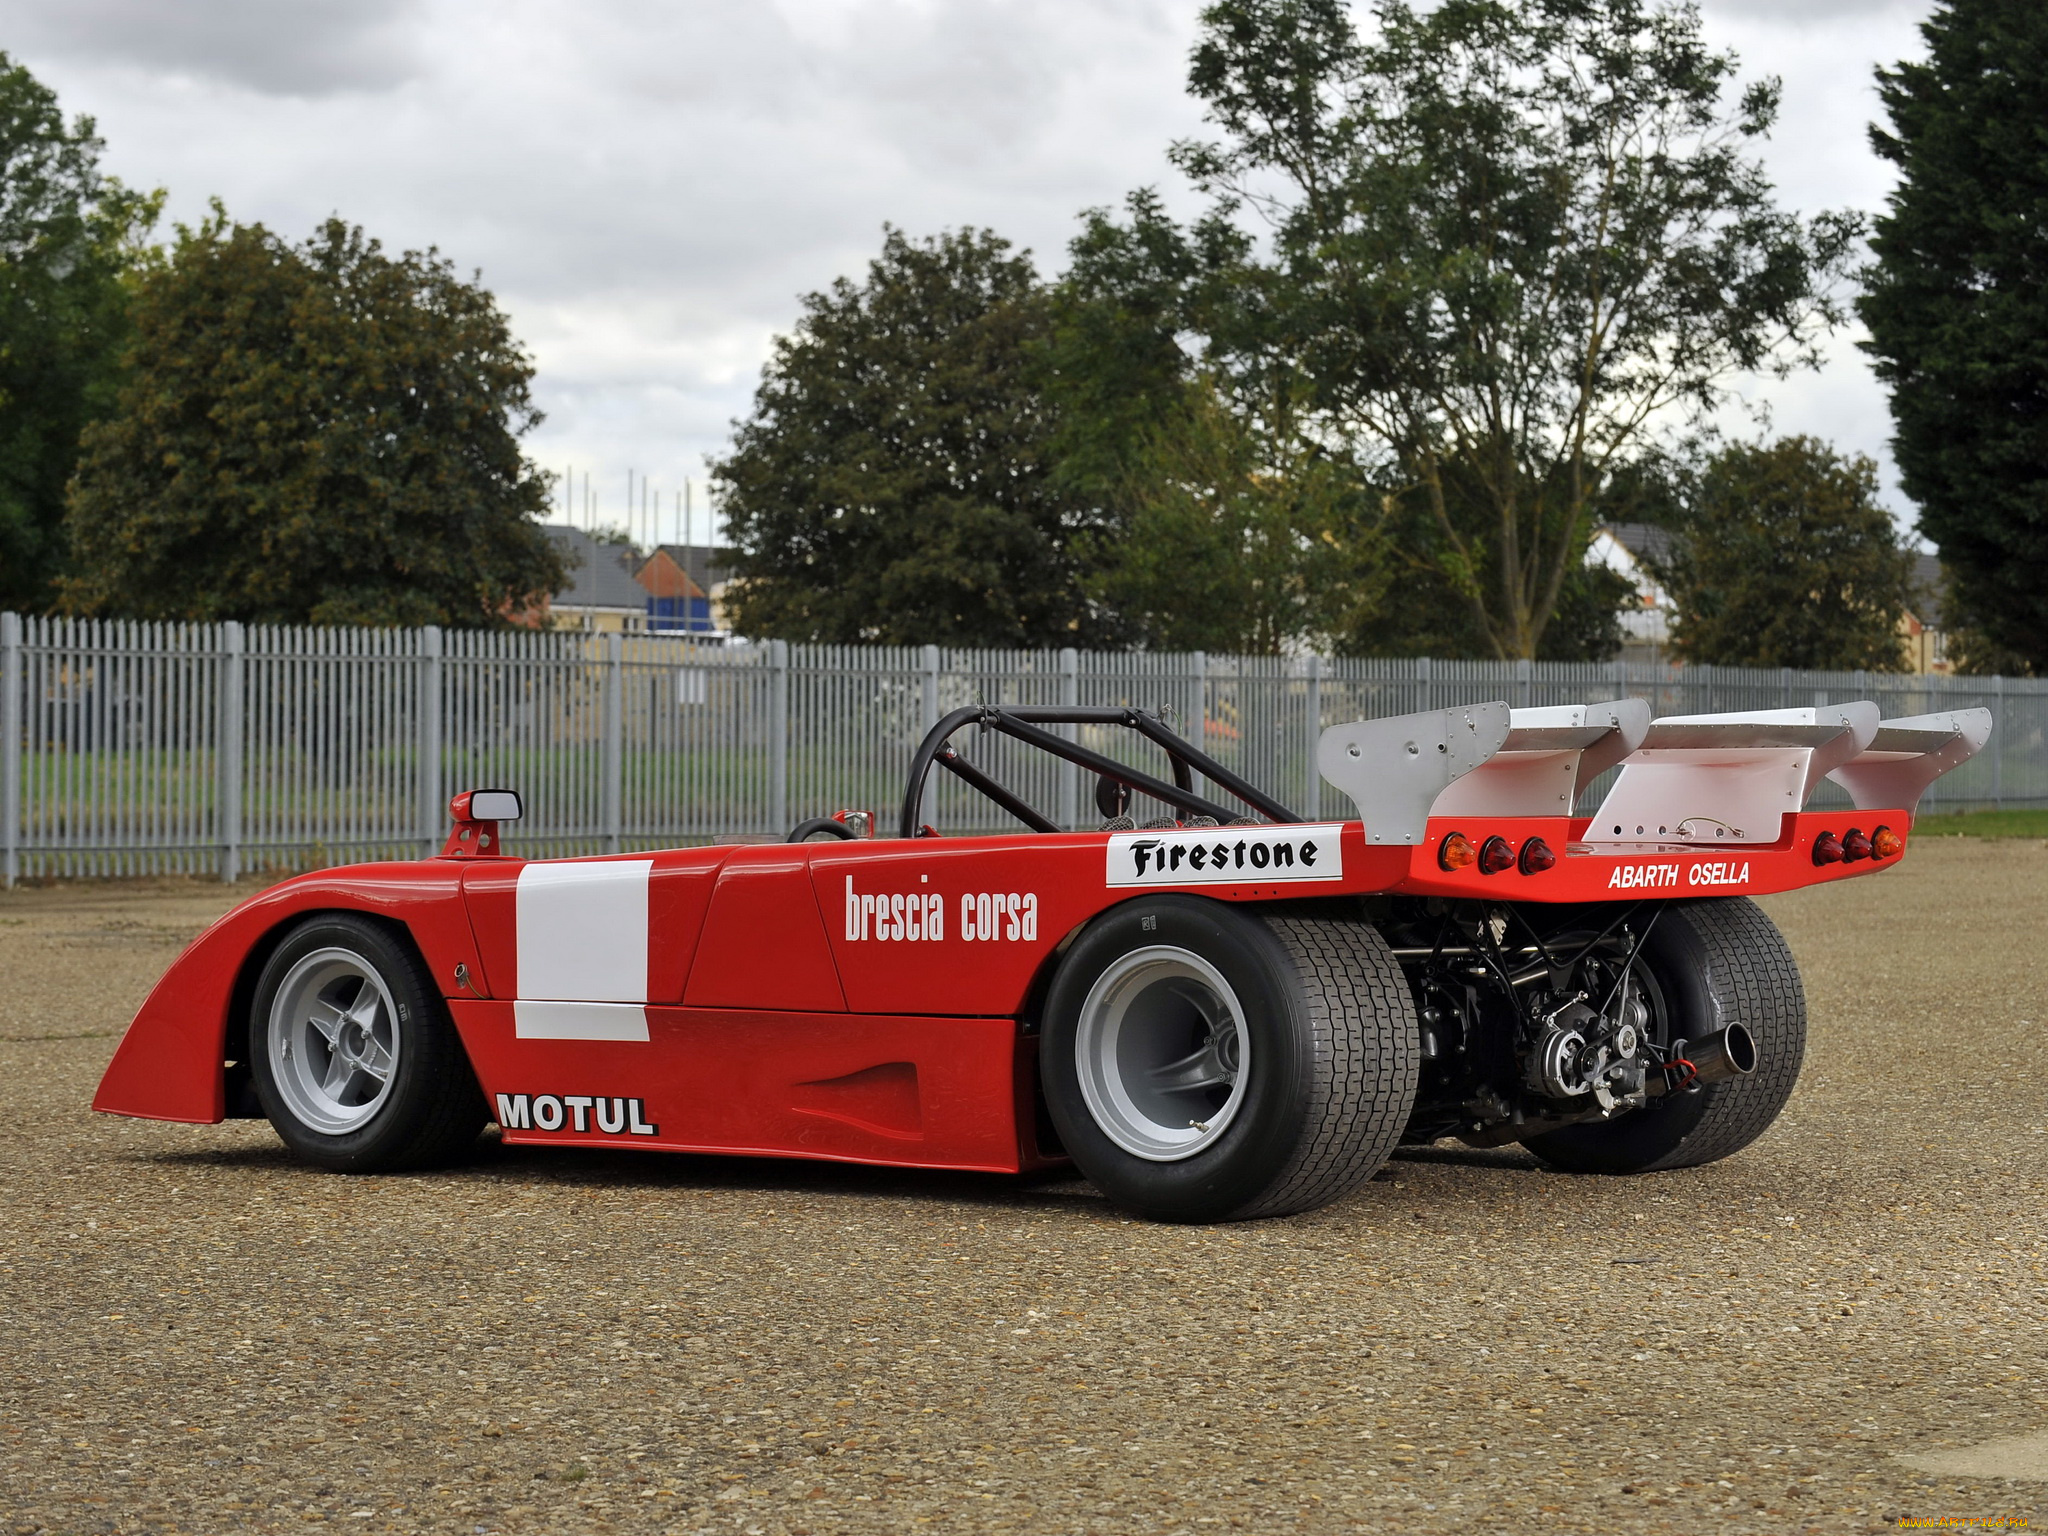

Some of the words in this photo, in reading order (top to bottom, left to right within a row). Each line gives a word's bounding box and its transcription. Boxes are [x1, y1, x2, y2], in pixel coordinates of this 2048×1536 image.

[1129, 838, 1318, 878] Firestone
[1608, 864, 1679, 888] ABARTH
[1688, 862, 1749, 886] OSELLA
[845, 874, 944, 942] brescia
[961, 893, 1038, 942] corsa
[496, 1093, 657, 1136] MOTUL
